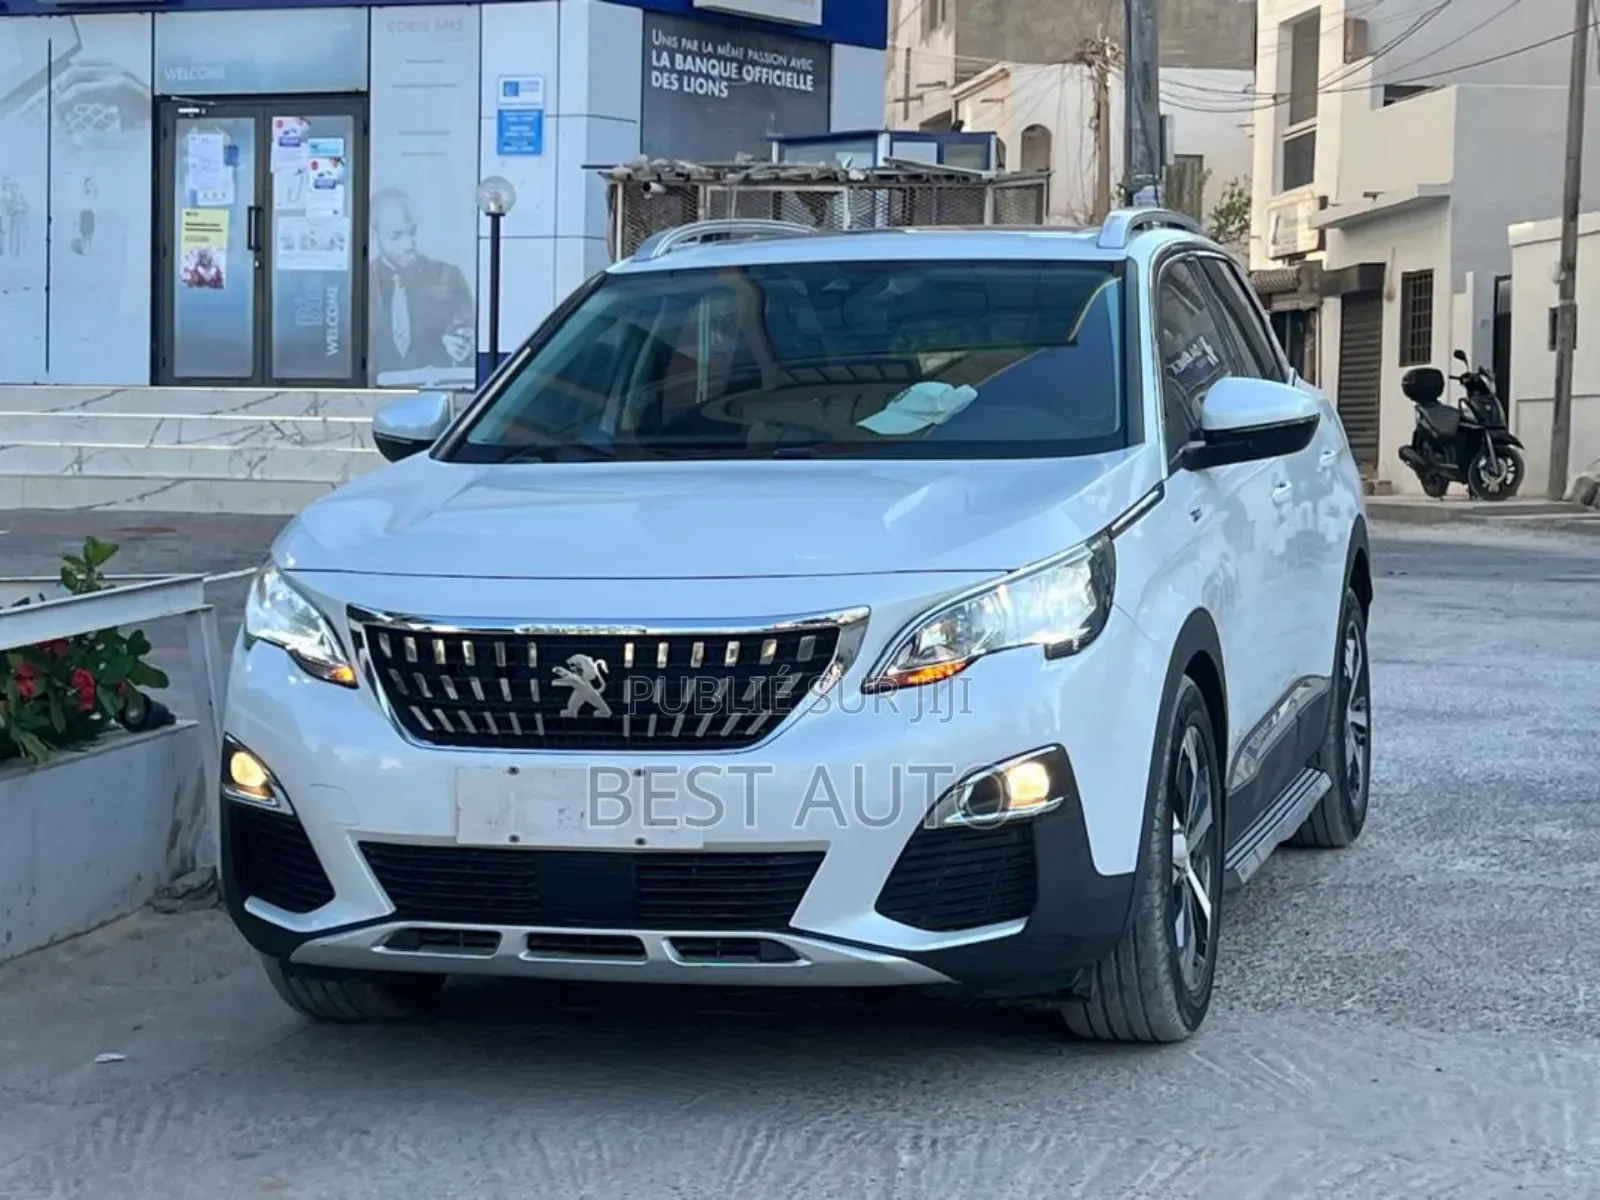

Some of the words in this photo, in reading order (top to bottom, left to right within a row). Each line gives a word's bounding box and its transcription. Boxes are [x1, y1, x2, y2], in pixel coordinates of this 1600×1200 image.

[651, 50, 671, 69] LA
[675, 53, 740, 79] BANQUE
[742, 64, 814, 92] OFFICIELLE
[680, 38, 699, 53] PAR
[701, 42, 714, 54] LA
[717, 41, 744, 60] MÊME
[748, 49, 788, 67] PASSION
[789, 57, 814, 72] AVEC
[164, 64, 225, 81] WELCOME
[651, 70, 679, 90] DES
[683, 74, 729, 99] LIONS
[325, 284, 340, 357] WELCOME
